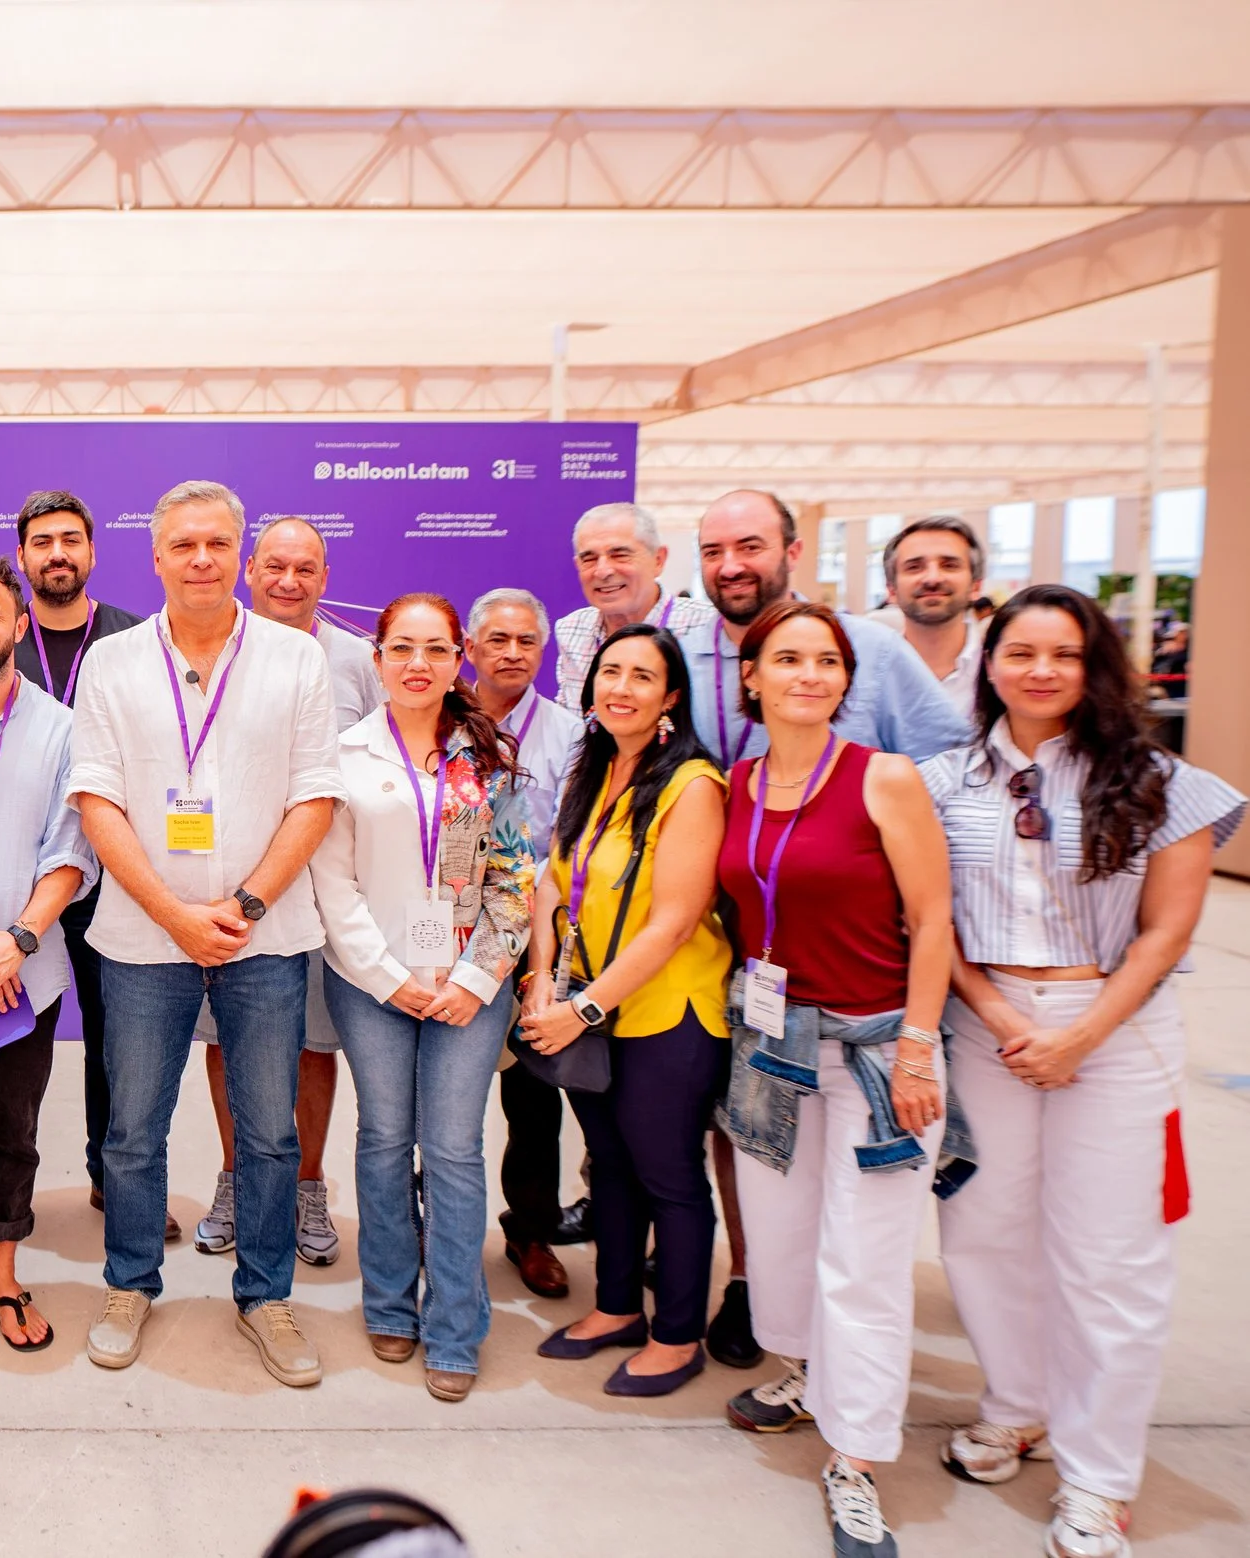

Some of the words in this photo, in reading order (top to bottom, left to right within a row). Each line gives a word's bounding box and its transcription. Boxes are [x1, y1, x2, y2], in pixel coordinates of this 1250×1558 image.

[561, 453, 619, 462] DOMESTIC
[333, 461, 407, 480] Balloon
[407, 462, 470, 480] Latam
[491, 459, 516, 479] 31
[561, 462, 591, 471] DATA
[561, 470, 628, 480] STREAMERS
[118, 512, 137, 521] ¿Qué
